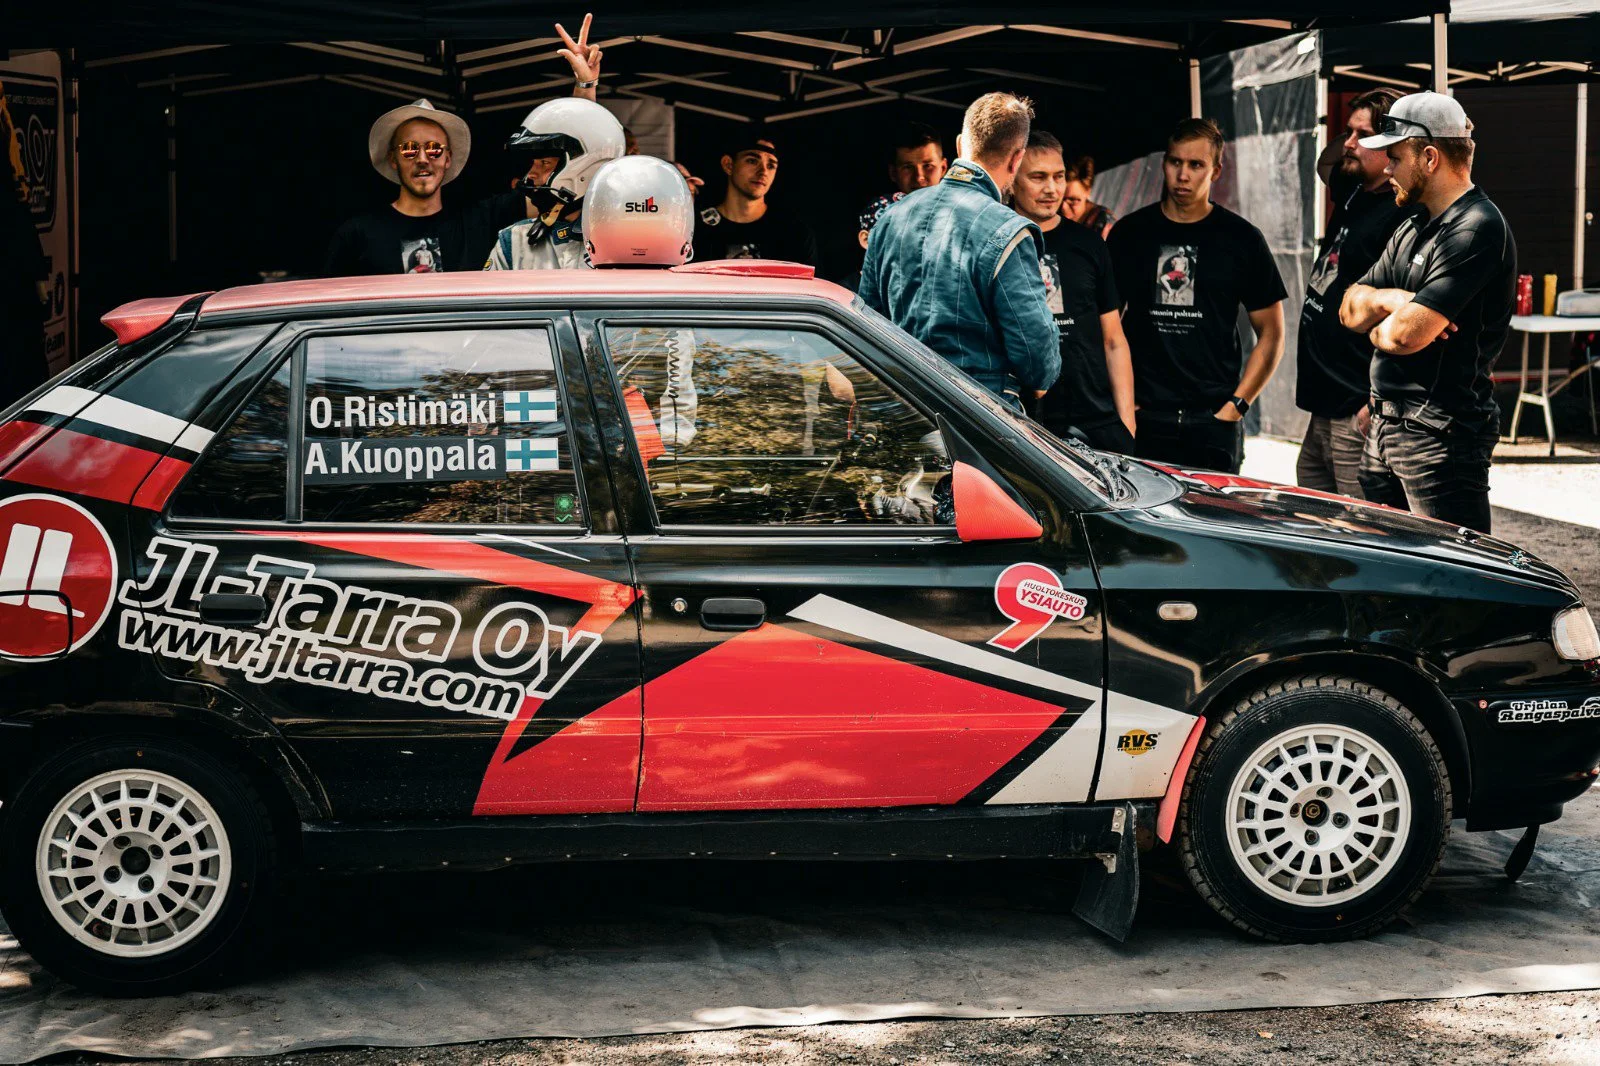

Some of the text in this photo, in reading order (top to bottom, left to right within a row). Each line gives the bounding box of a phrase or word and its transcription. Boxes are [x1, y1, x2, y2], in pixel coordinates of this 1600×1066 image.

[625, 196, 658, 213] Stilo
[310, 393, 496, 429] O.Ristimäki
[304, 439, 496, 480] A.Kuoppala
[1020, 589, 1082, 617] YSIAUTO
[1024, 582, 1085, 606] HUOLTOKESKUS
[119, 536, 602, 699] JL-Tarra Oy
[118, 610, 526, 720] www.jltarra.com
[1511, 700, 1568, 712] Urjalan
[1117, 733, 1158, 748] RVS
